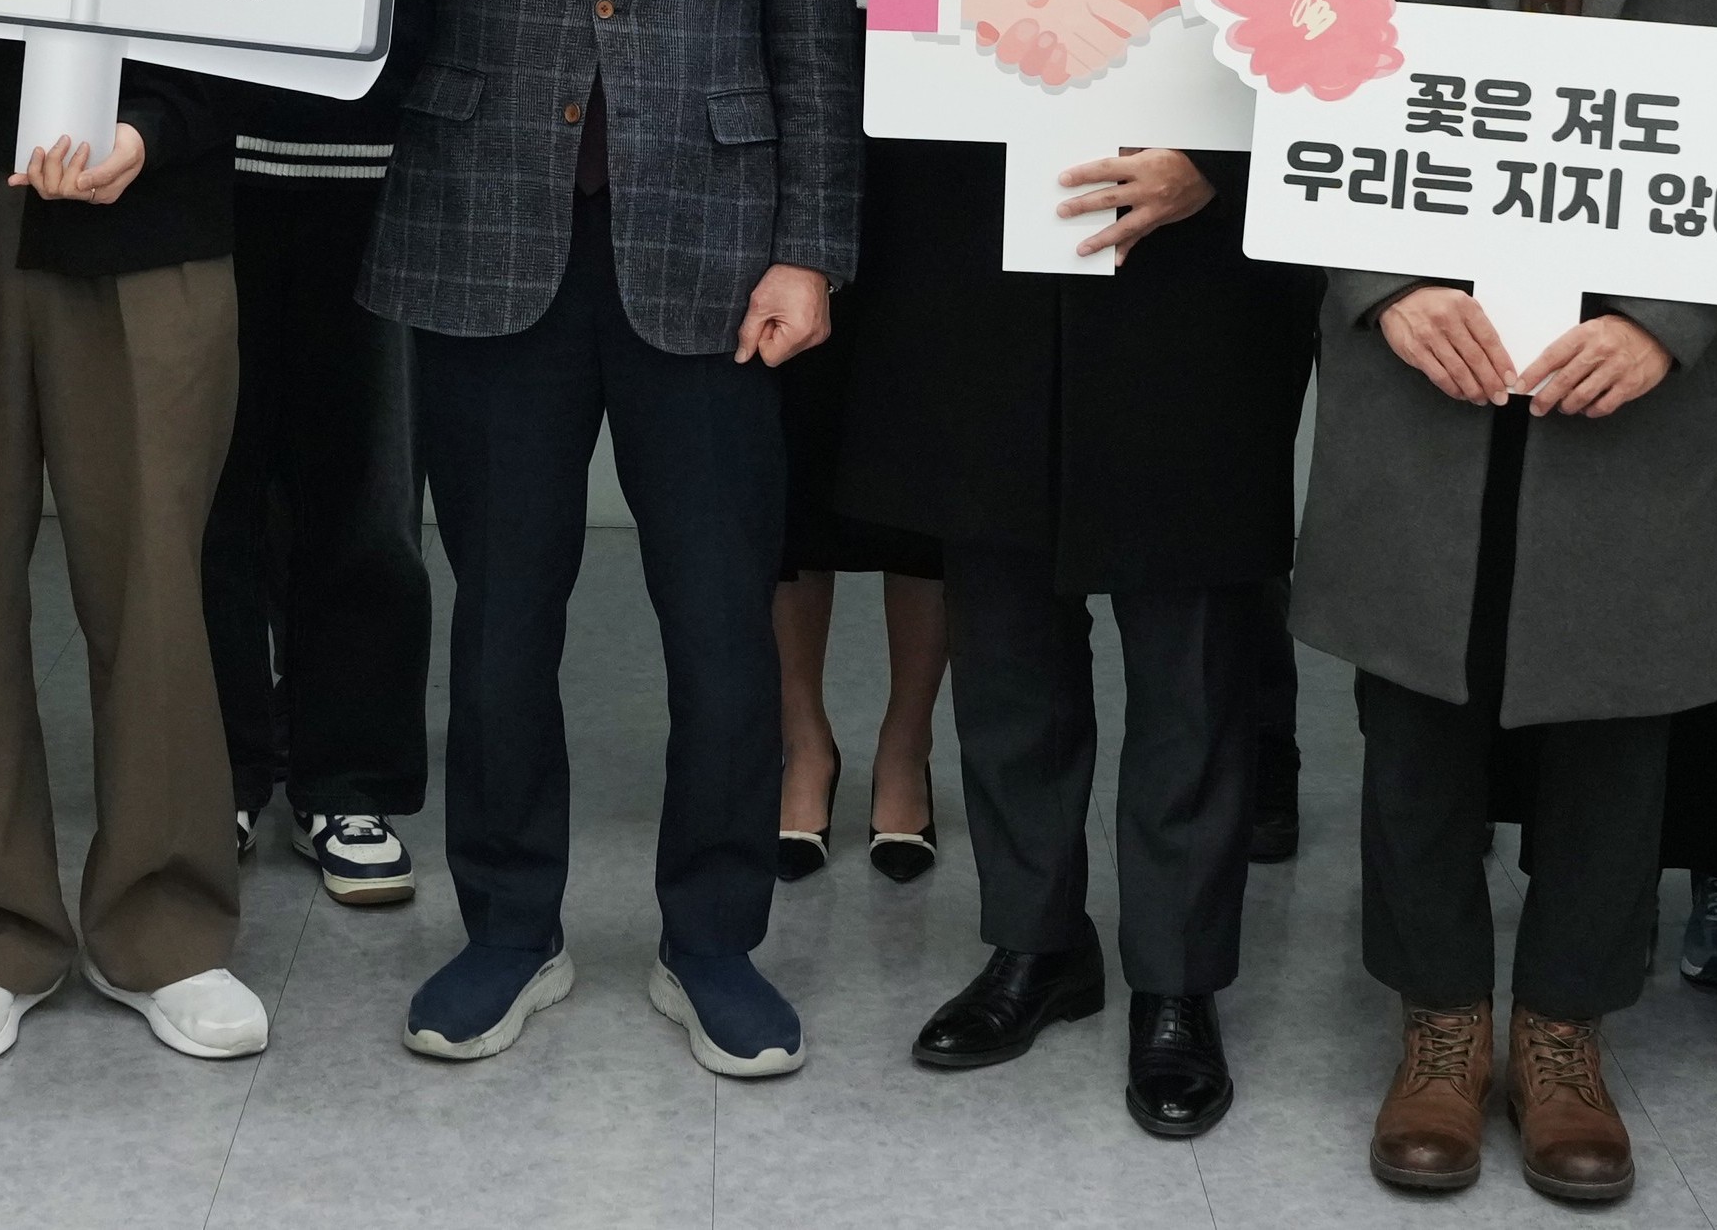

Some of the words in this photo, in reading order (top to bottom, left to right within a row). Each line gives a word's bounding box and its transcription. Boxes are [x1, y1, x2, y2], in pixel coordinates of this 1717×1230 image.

[1406, 73, 1531, 142] 꽃은
[1552, 87, 1680, 154] 져도
[1284, 141, 1472, 215] 우리는
[1493, 160, 1622, 229] 지지
